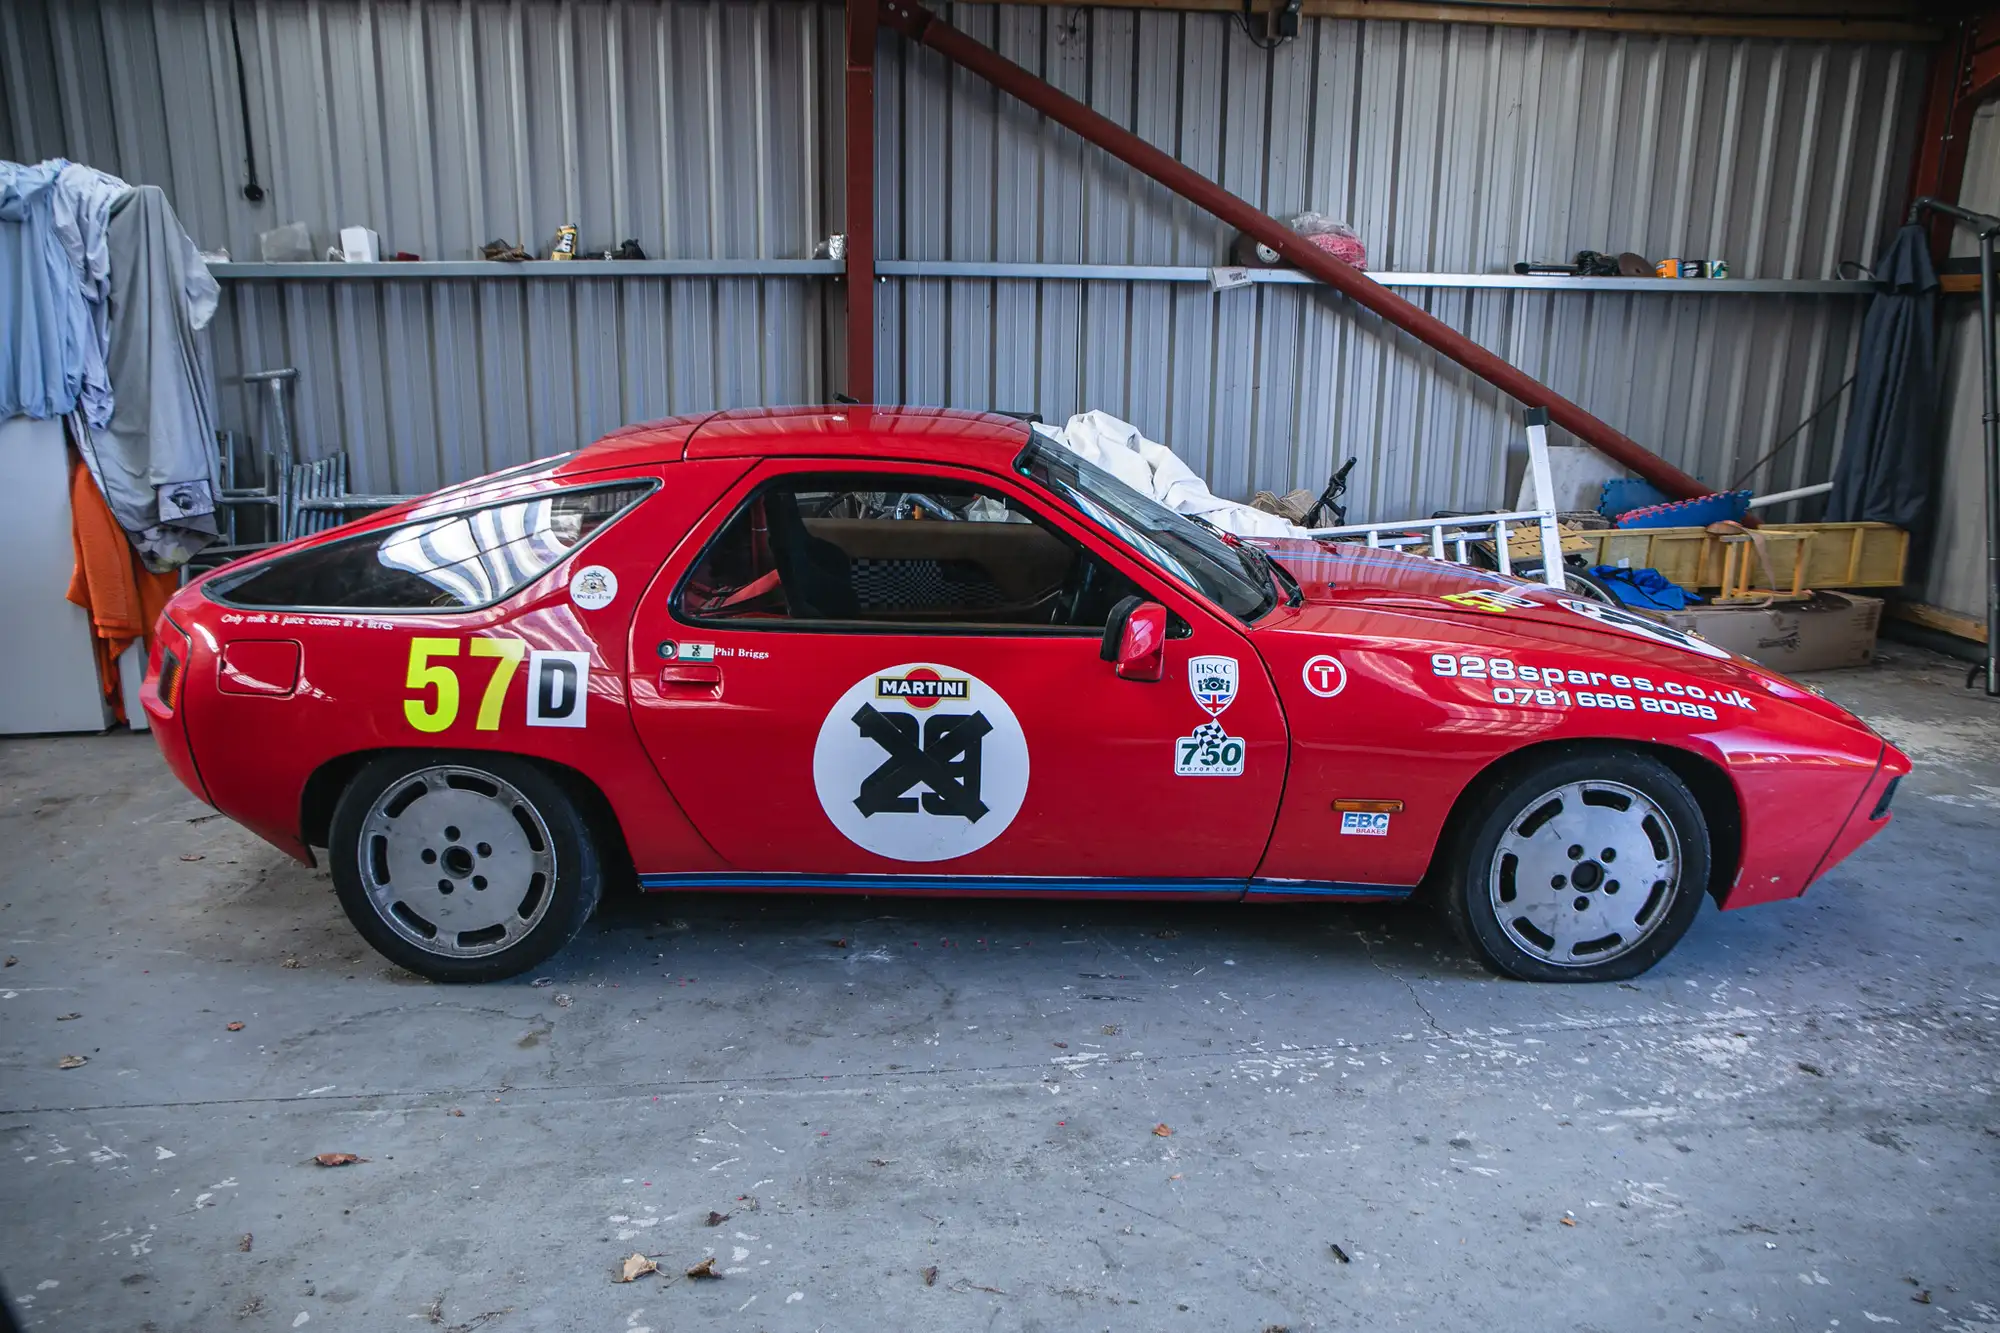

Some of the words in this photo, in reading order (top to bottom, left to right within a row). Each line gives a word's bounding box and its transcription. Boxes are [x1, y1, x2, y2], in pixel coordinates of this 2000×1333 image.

[221, 613, 245, 625] Only
[246, 614, 268, 624] milk
[270, 615, 280, 624] &
[282, 615, 305, 626] juice
[308, 616, 341, 627] comes
[343, 619, 353, 628] in
[356, 618, 364, 629] 2
[715, 647, 734, 657] Phil
[738, 648, 769, 660] Briggs
[1196, 663, 1233, 675] HSCC
[403, 637, 526, 733] 57
[538, 659, 577, 718] D
[882, 680, 964, 696] MARTINI
[1431, 653, 1757, 712] 928spares.co.uk
[1493, 686, 1572, 708] 0781
[1577, 691, 1637, 711] 666
[1641, 697, 1719, 721] 8088
[1181, 742, 1242, 767] 750
[1343, 812, 1388, 829] EBC
[1356, 828, 1386, 836] BRAKES
